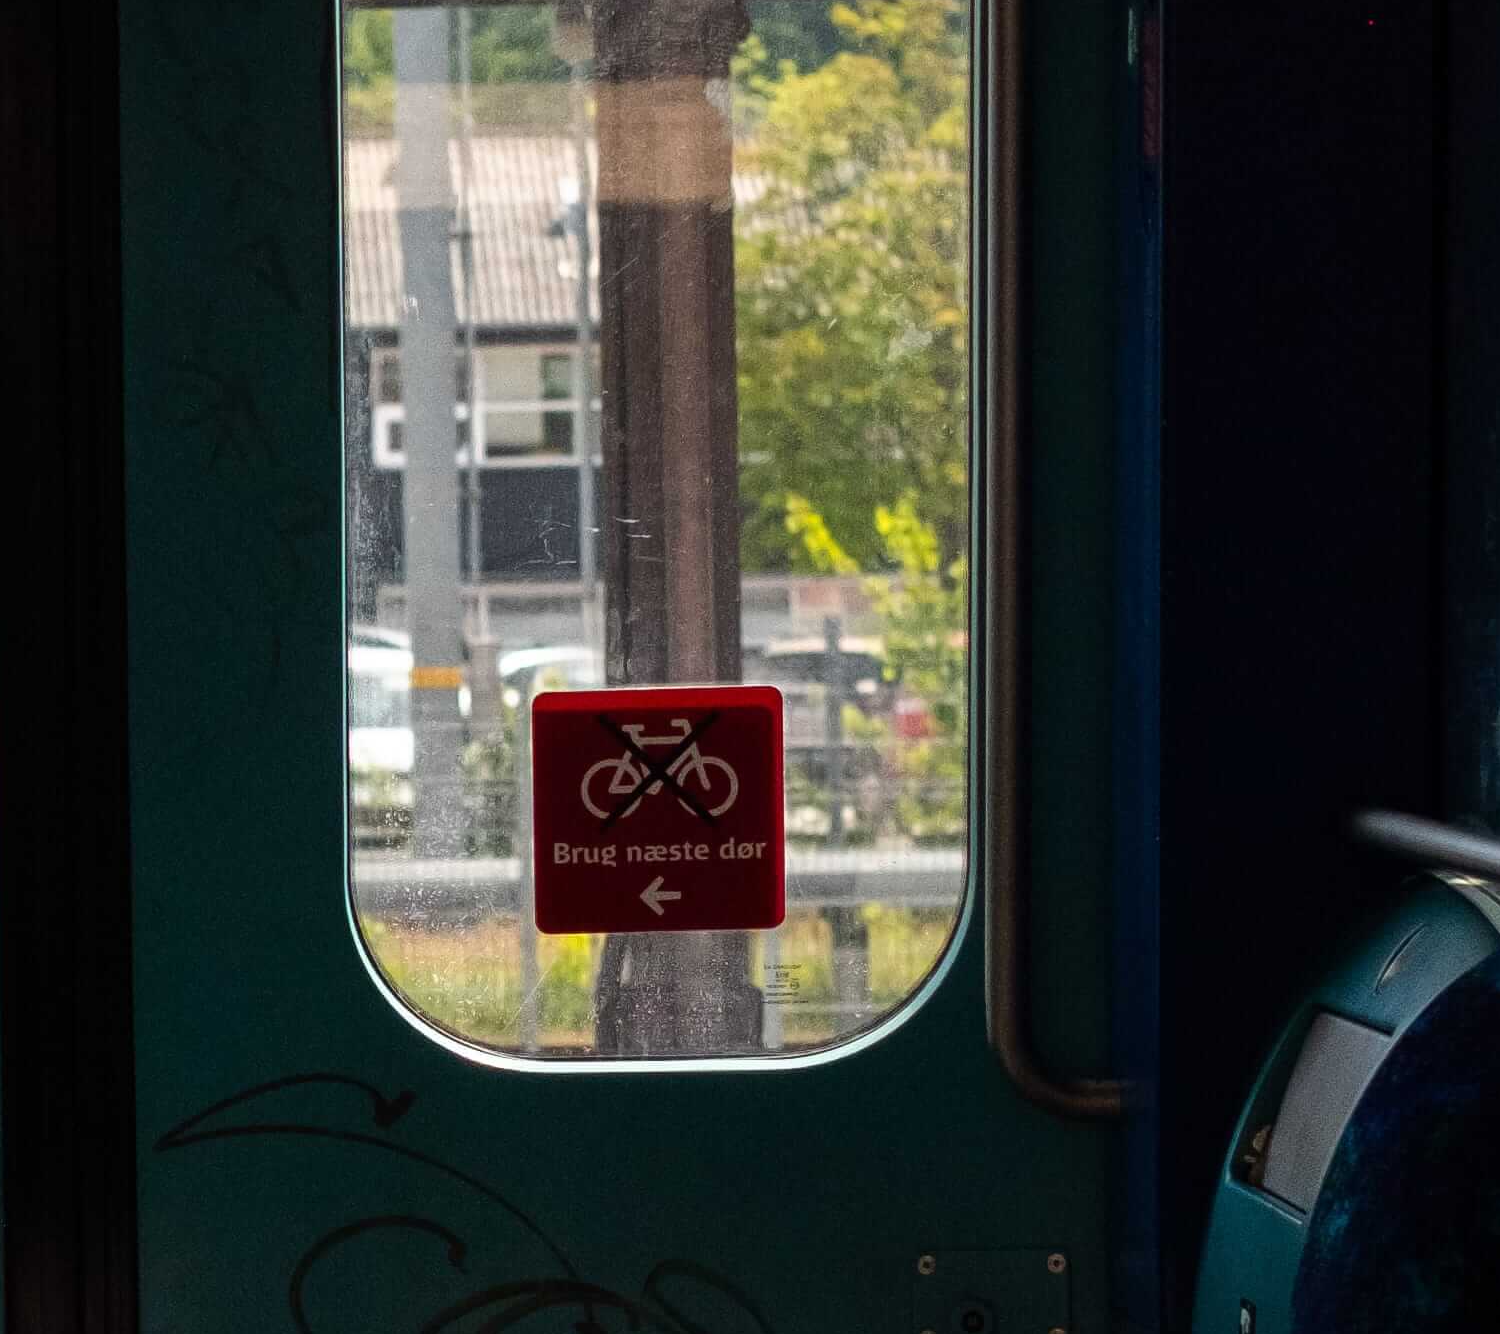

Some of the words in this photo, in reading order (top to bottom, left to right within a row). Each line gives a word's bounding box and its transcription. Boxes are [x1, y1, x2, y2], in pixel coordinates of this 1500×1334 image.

[553, 842, 617, 868] Brug
[626, 841, 711, 863] næste
[718, 836, 767, 860] dør
